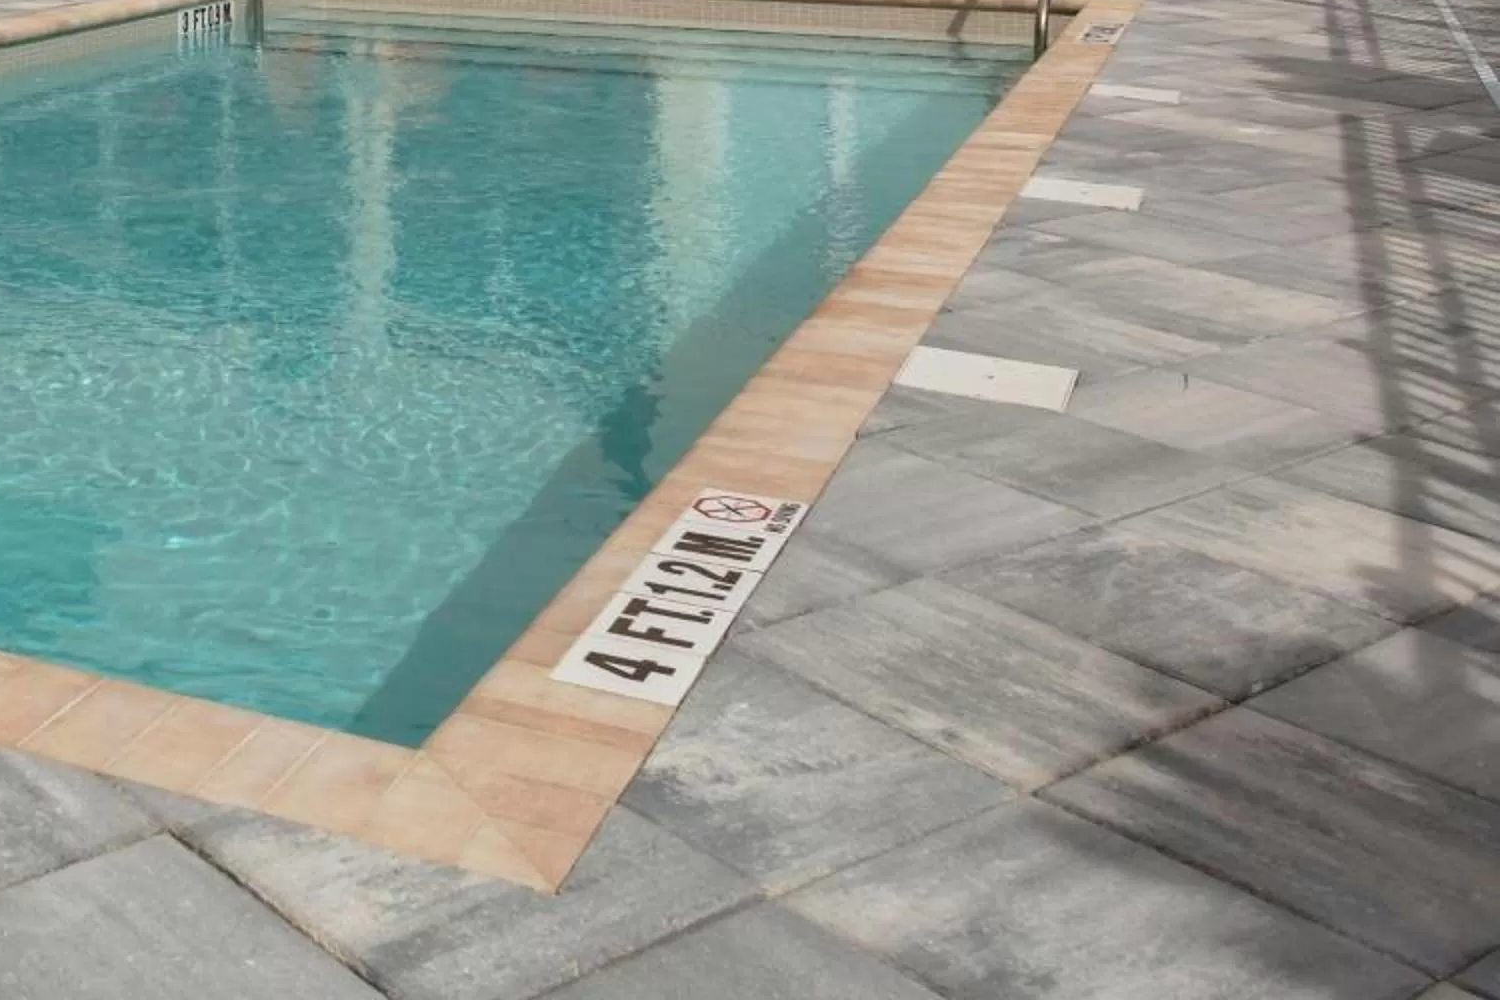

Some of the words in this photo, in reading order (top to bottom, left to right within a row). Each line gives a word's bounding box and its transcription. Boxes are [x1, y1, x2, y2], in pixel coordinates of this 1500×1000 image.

[672, 531, 765, 562] M.
[606, 598, 715, 649] FT.
[584, 651, 676, 682] 4
